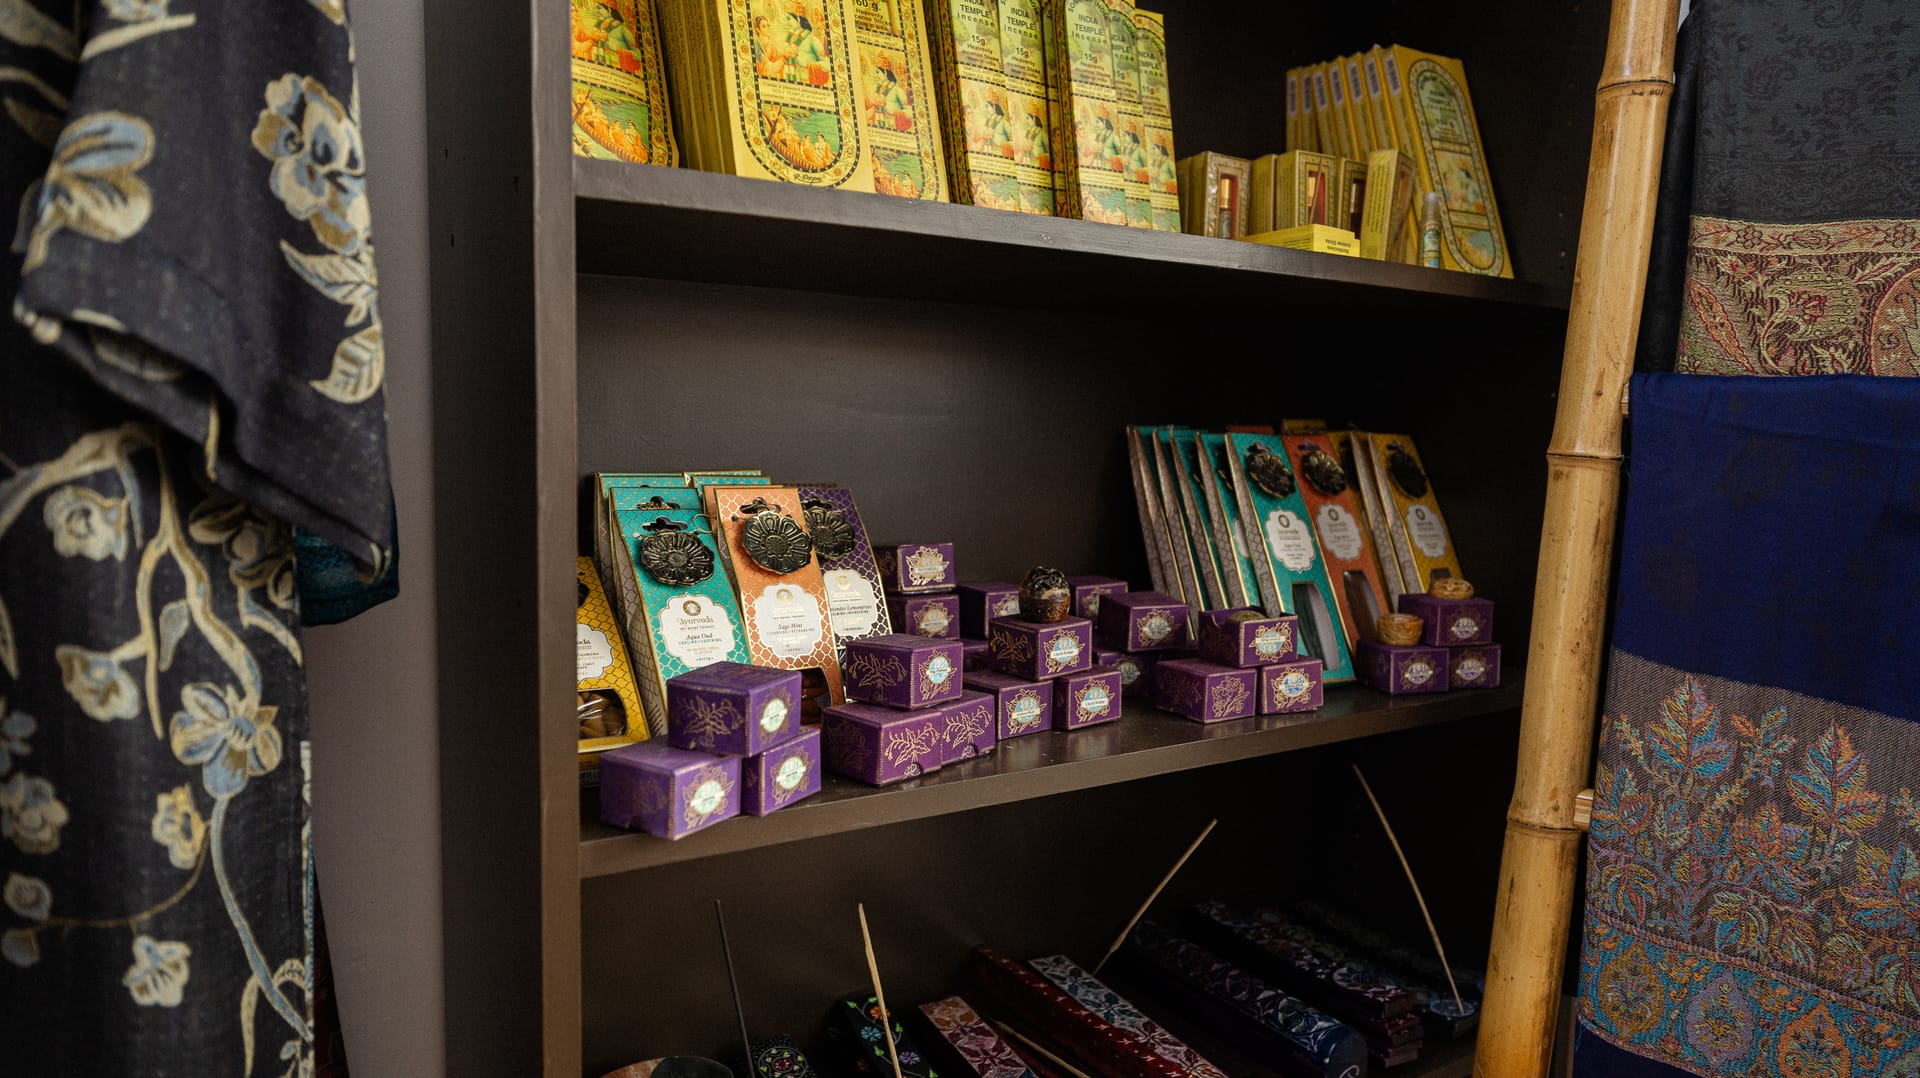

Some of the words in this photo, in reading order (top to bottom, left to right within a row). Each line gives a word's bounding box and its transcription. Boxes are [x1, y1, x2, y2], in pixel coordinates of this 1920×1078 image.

[960, 4, 991, 18] TEMPLE
[1010, 8, 1030, 18] INDIA
[958, 12, 994, 28] Incense
[1006, 16, 1035, 30] TEMPLE
[1078, 14, 1098, 24] INDIA
[1004, 24, 1038, 40] Incense
[1074, 23, 1104, 36] TEMPLE
